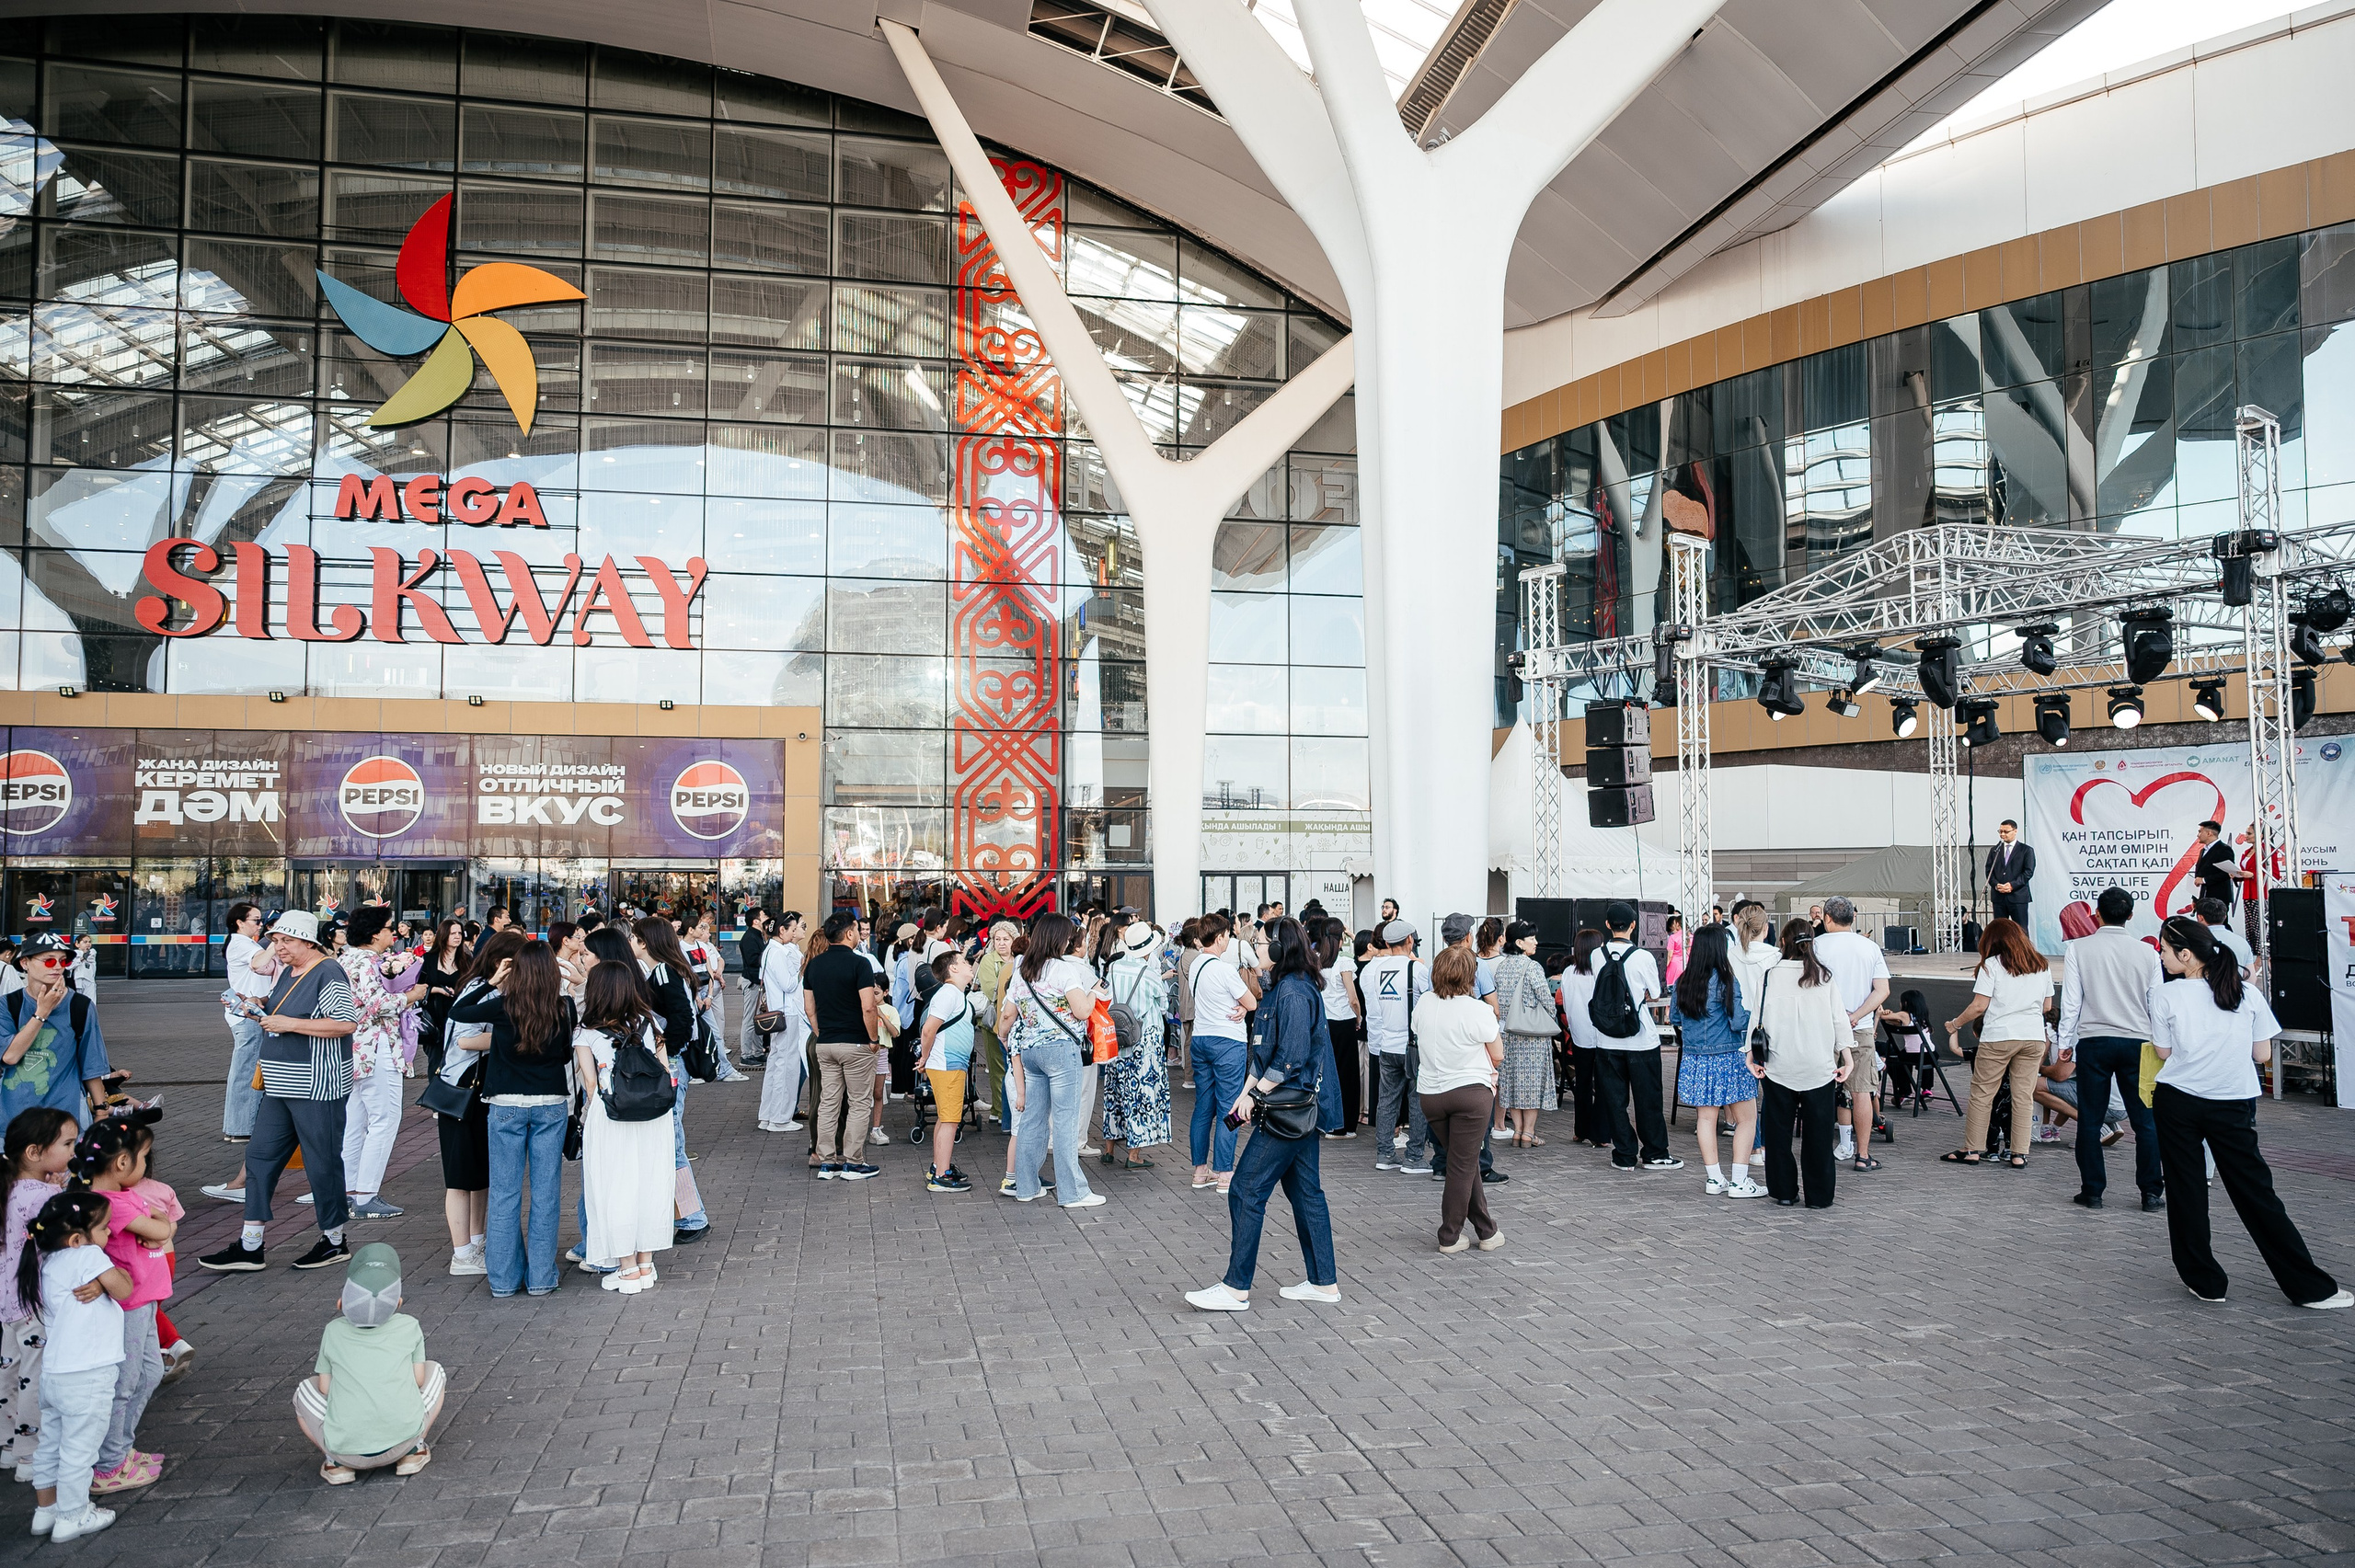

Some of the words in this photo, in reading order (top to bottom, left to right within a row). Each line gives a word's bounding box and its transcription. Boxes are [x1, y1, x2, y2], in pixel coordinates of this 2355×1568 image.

[333, 473, 549, 527] MEGA
[134, 537, 708, 649] SILKWAY
[137, 760, 198, 773] ЖАҢА
[201, 758, 279, 771] ДИЗАЙН
[2202, 755, 2240, 764] AMANAT
[479, 762, 547, 775] НОВЫЙ
[549, 763, 626, 776] ДИЗАЙН
[134, 771, 281, 789] КЕРЕМЕТ
[478, 777, 626, 794] ОТЛИЧНЫЙ
[1, 784, 65, 801] EPSI
[345, 788, 419, 805] PEPSI
[676, 792, 744, 807] PEPSI
[133, 790, 279, 825] ДӘМ
[477, 795, 625, 826] ВКУС
[1231, 823, 1277, 831] АШЫЛАДЫ
[1304, 823, 1348, 831] ЖАҚЫНДА
[2062, 831, 2086, 842] ҚАН
[2090, 830, 2174, 841] ТАПСЫРЫП,
[2079, 844, 2117, 855] АДАМ
[2121, 843, 2168, 854] ӨМІРІН
[2086, 858, 2137, 869] САҚТАП
[2142, 858, 2174, 869] ҚАЛ!
[2301, 858, 2328, 866] ЮНЬ
[2073, 876, 2105, 887] SAVE
[2108, 876, 2118, 887] A
[2120, 876, 2149, 887] LIFE
[2070, 890, 2098, 900] GIVE
